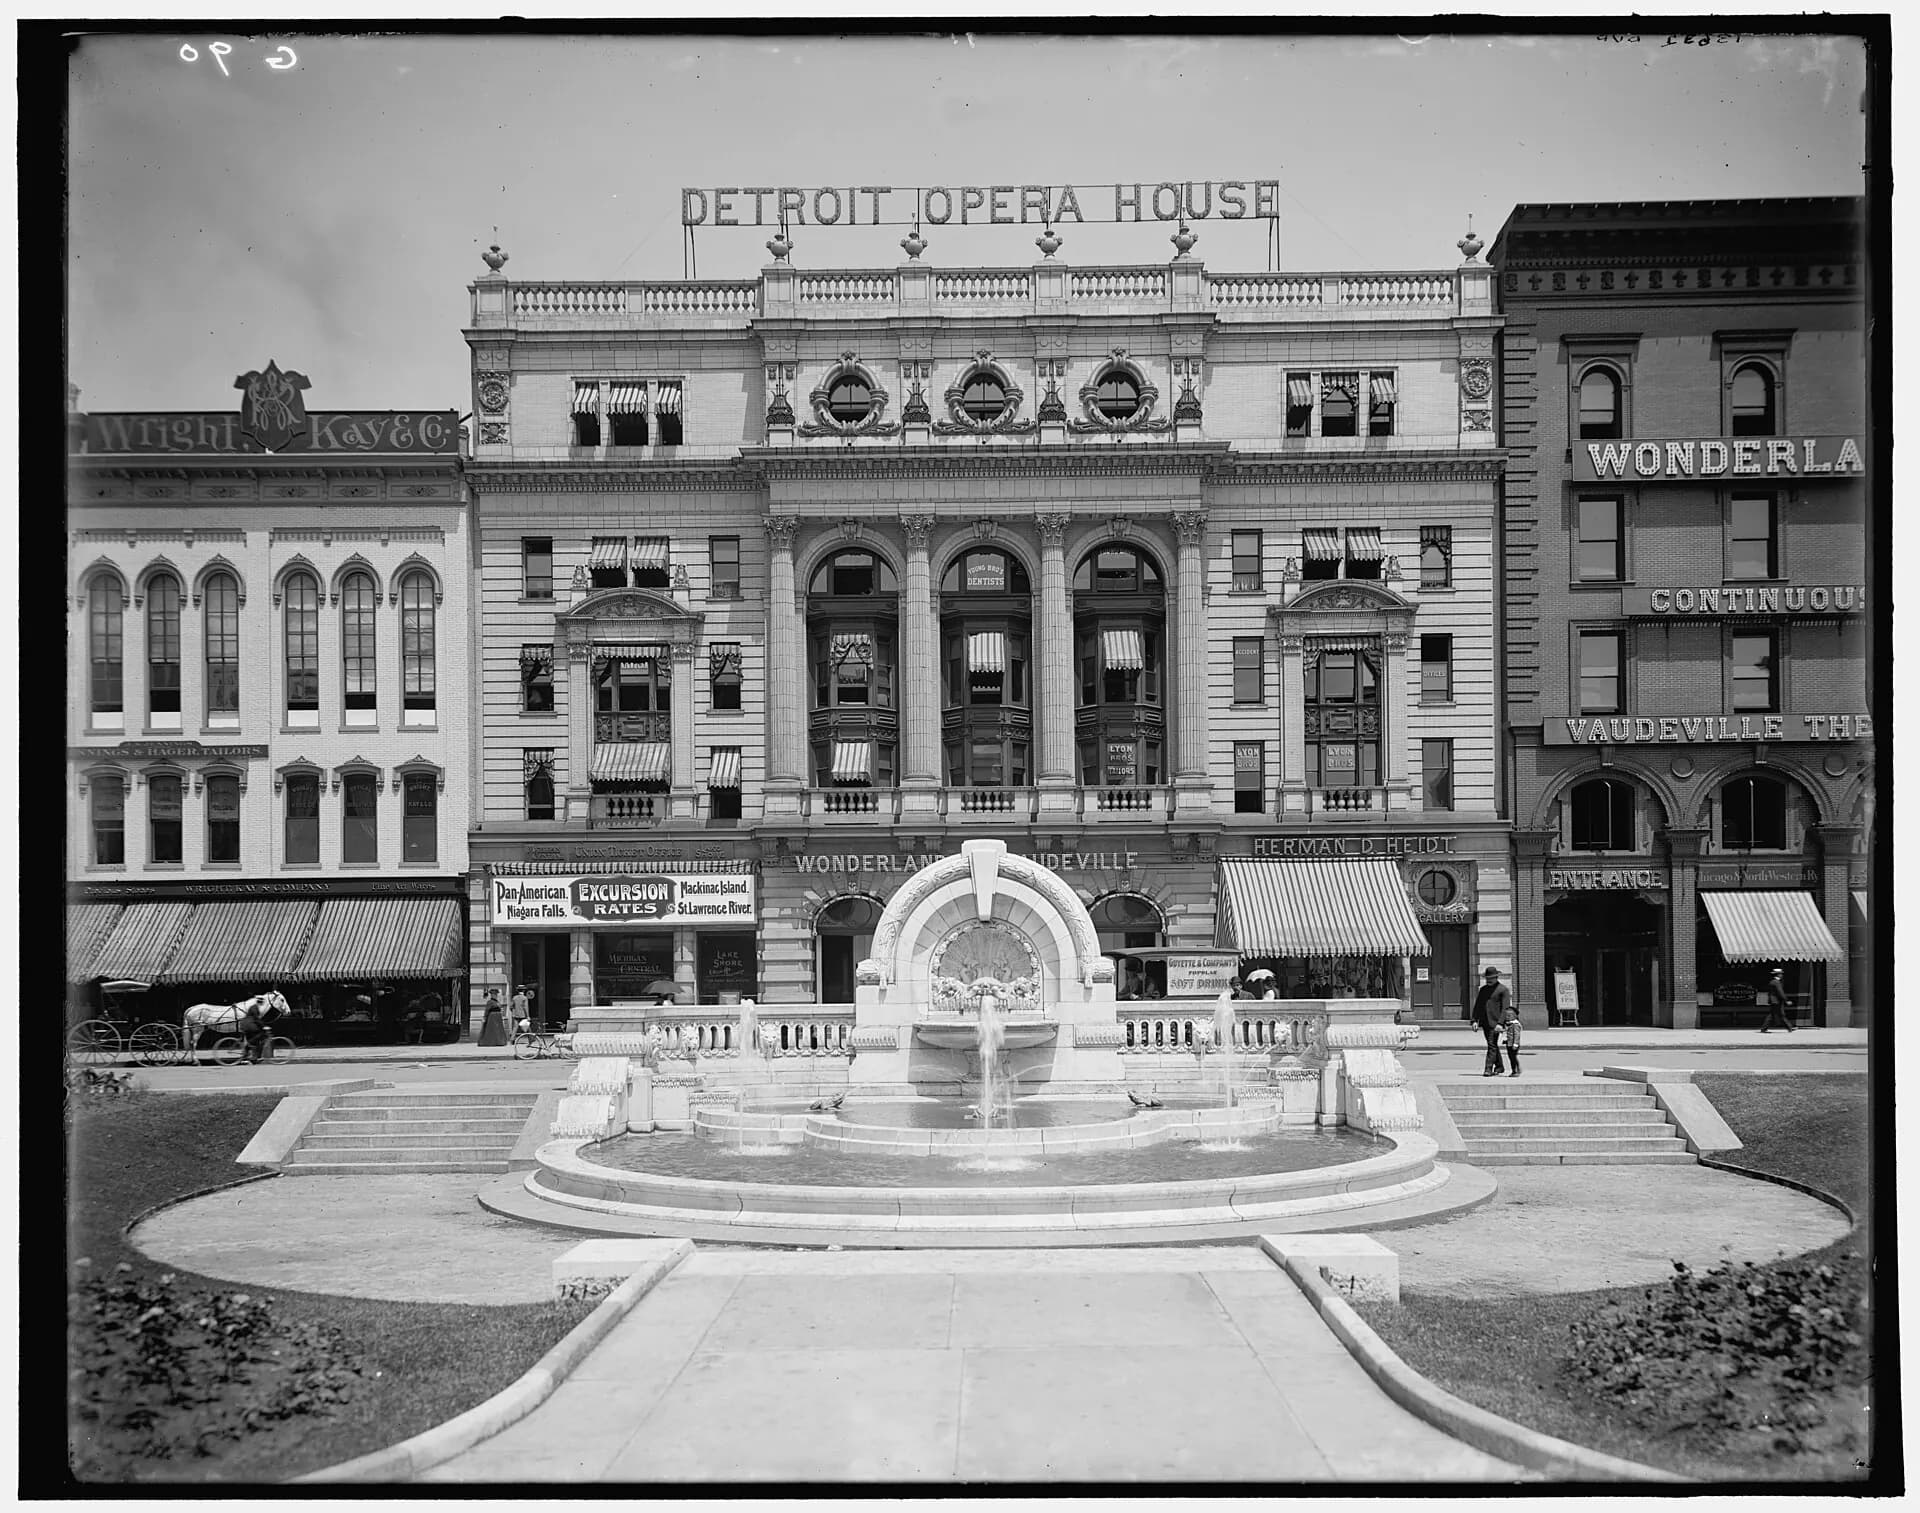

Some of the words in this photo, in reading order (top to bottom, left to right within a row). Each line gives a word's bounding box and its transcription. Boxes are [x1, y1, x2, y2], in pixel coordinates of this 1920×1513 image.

[681, 186, 892, 226] DETROIT
[924, 184, 1084, 224] OPERA
[1115, 179, 1280, 222] HOUSE
[307, 414, 391, 450] Kay
[390, 414, 414, 449] &
[418, 413, 452, 449] Co.
[1588, 437, 1864, 477] WONDERLA
[967, 577, 1004, 586] DENTISTS
[1567, 715, 1783, 742] VAUDEVILLE
[1804, 714, 1873, 738] THE
[1109, 744, 1134, 754] LYON
[1236, 746, 1260, 758] LYON
[1327, 747, 1354, 757] LYON
[575, 845, 605, 858] UNION
[1253, 837, 1345, 856] HERMAN
[1387, 836, 1456, 854] HEIDT
[1550, 869, 1663, 888] ENTRANCE
[1697, 869, 1733, 884] hicago
[273, 882, 331, 893] COMPANY
[578, 882, 669, 902] EXCURSION
[680, 880, 720, 898] Mackinac
[495, 880, 569, 914] Pan-American.
[507, 904, 540, 920] Niagara
[542, 903, 568, 918] Falls.
[593, 902, 658, 915] RATES
[1418, 912, 1465, 923] GALLERY
[716, 950, 739, 960] LAKE
[712, 958, 743, 969] SHORE
[1170, 979, 1195, 989] SOFT
[1197, 978, 1235, 990] DRINK
